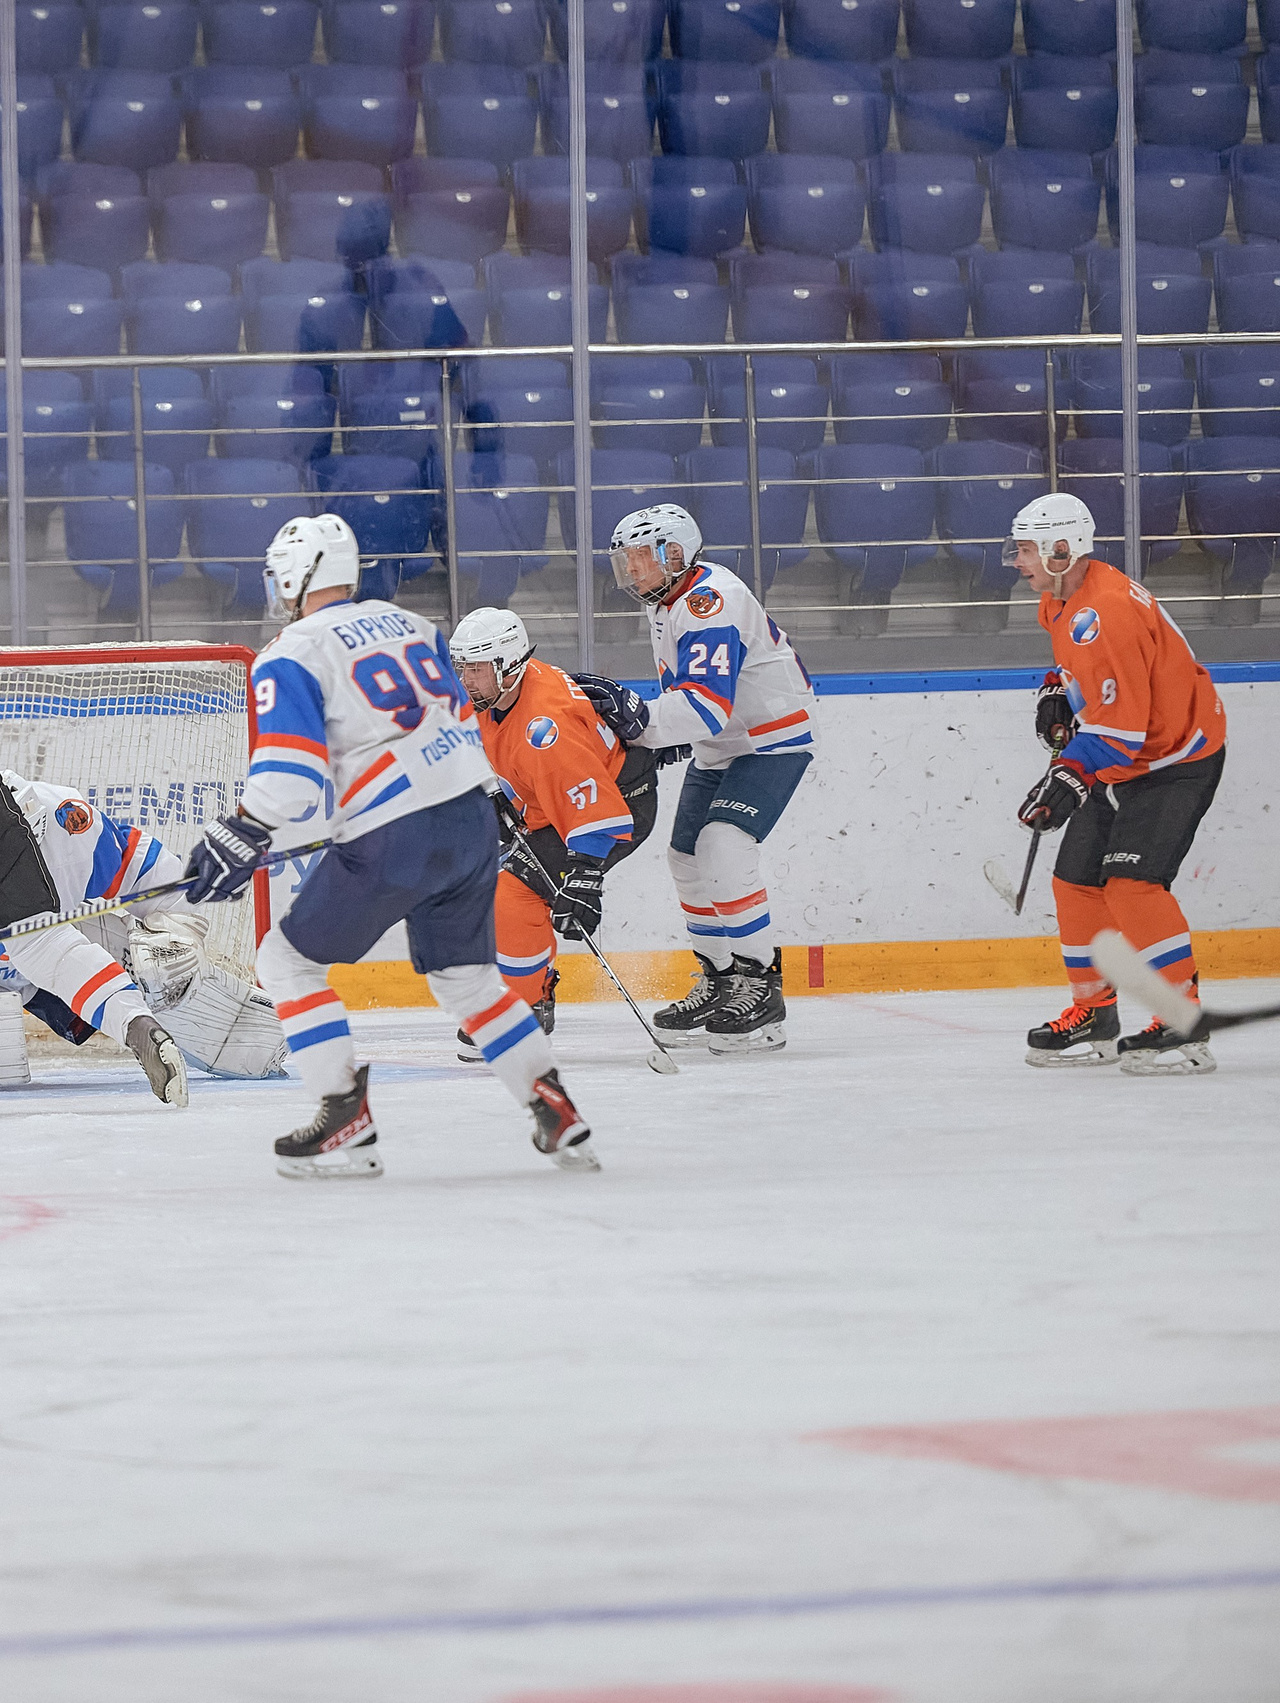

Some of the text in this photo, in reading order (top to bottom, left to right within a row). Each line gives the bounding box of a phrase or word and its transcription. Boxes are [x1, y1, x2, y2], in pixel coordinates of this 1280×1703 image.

[332, 613, 416, 650] БУРКОВ
[688, 643, 730, 676] 24
[255, 678, 276, 715] 9
[351, 641, 459, 731] 99
[1101, 678, 1117, 705] 8
[566, 777, 598, 810] 57
